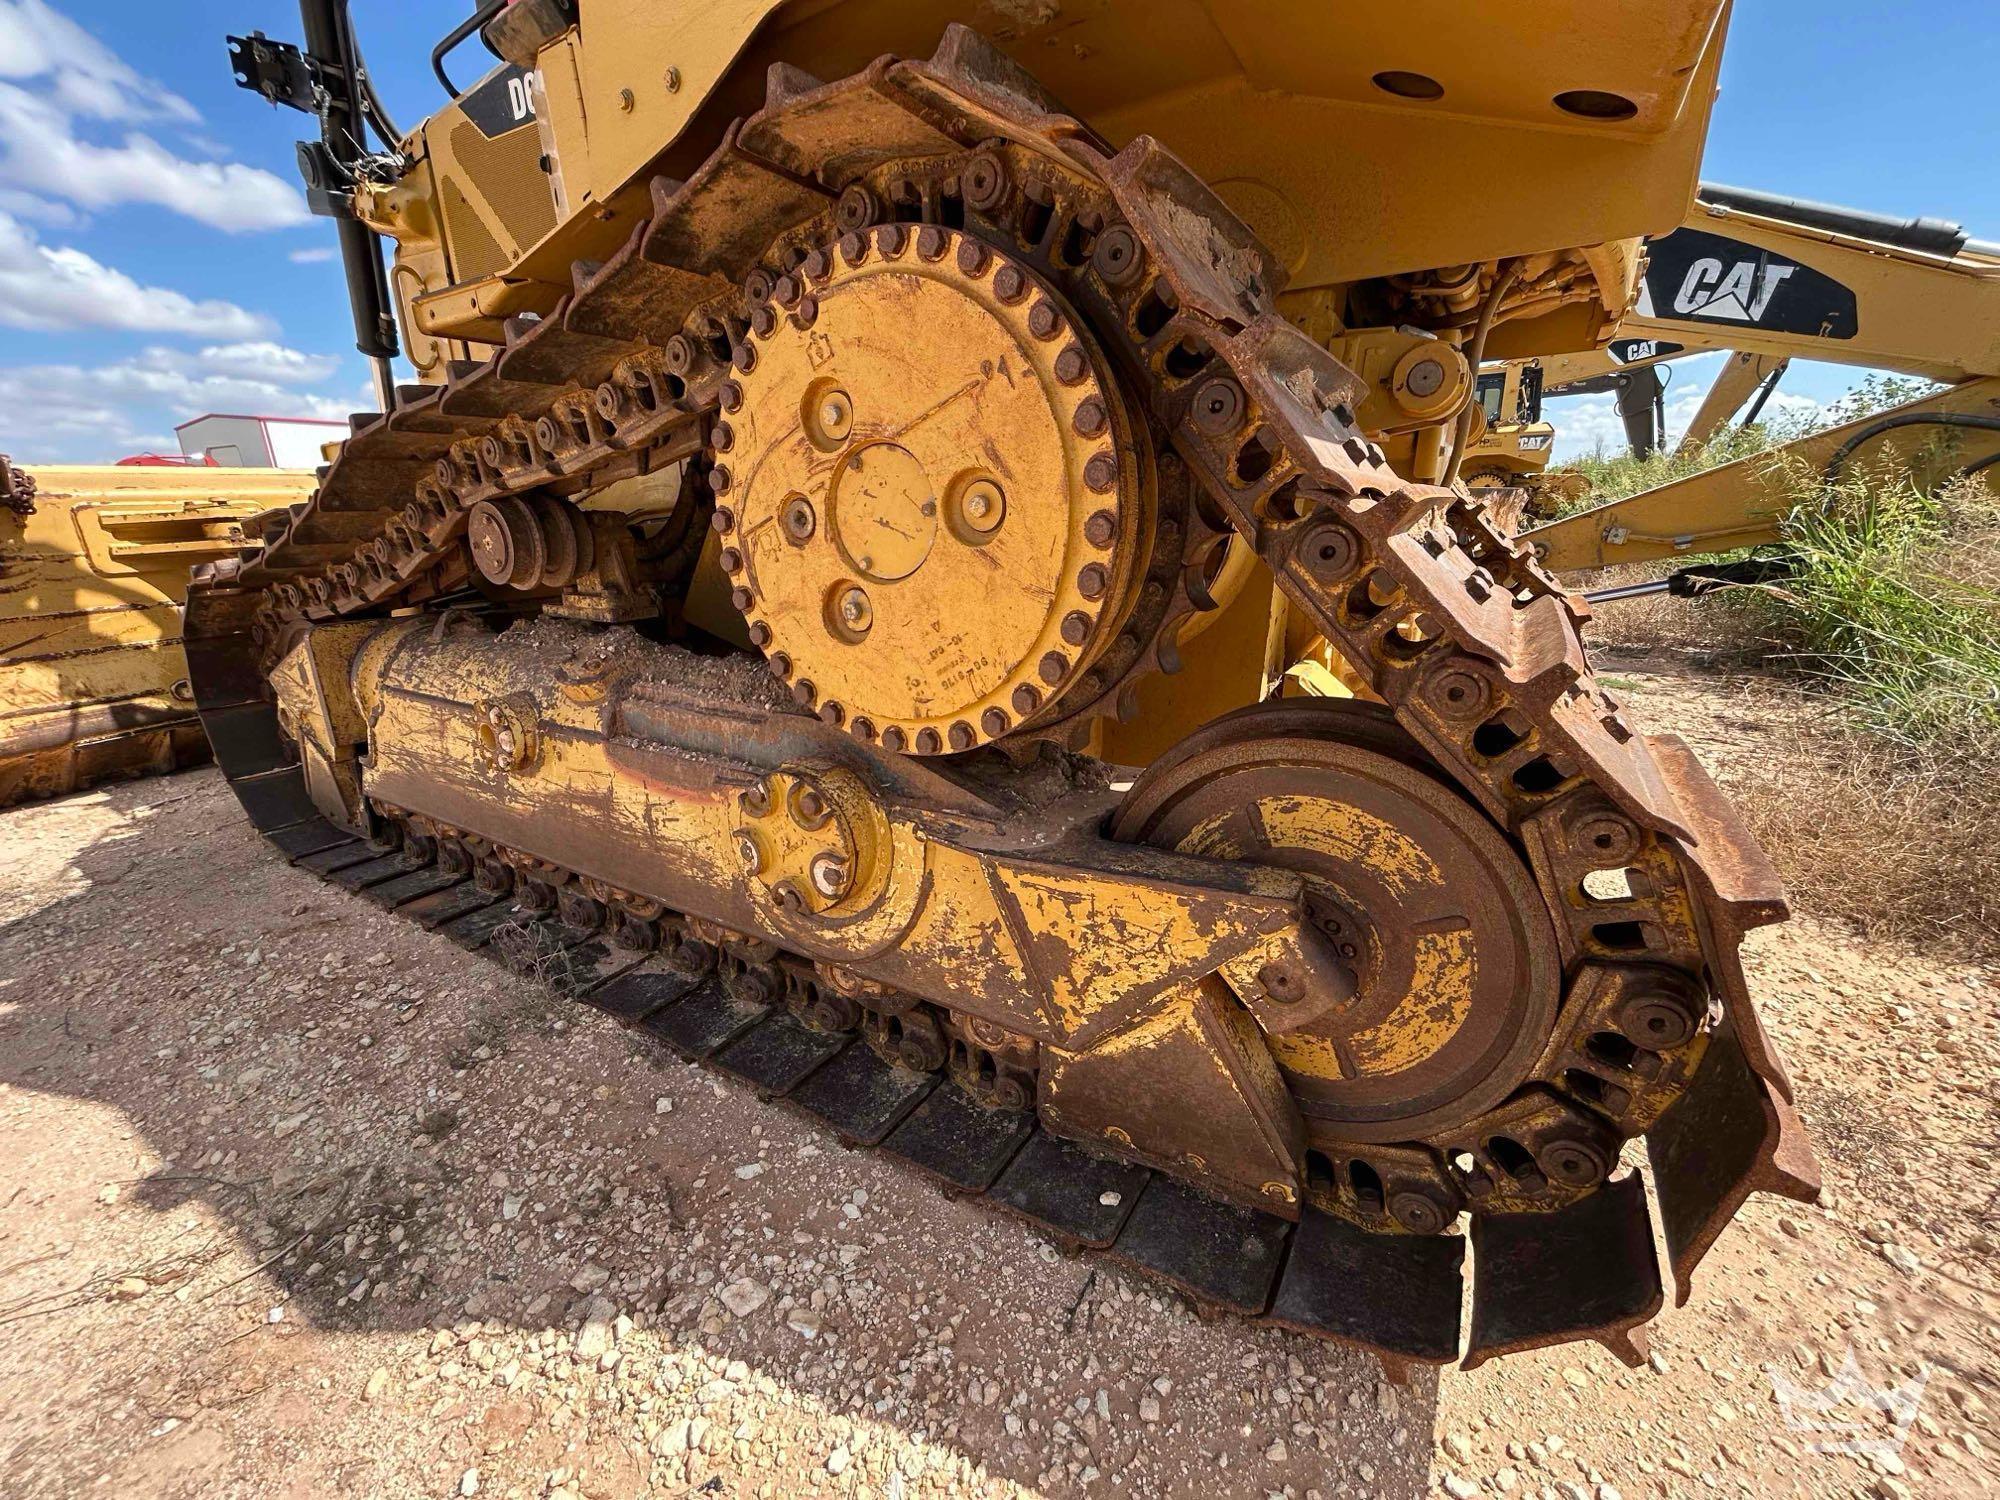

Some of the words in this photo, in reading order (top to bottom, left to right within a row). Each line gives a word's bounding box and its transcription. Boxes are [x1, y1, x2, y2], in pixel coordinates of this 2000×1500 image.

[1673, 257, 1795, 322] CAT
[1627, 340, 1657, 361] CAT
[1519, 437, 1543, 450] CAT
